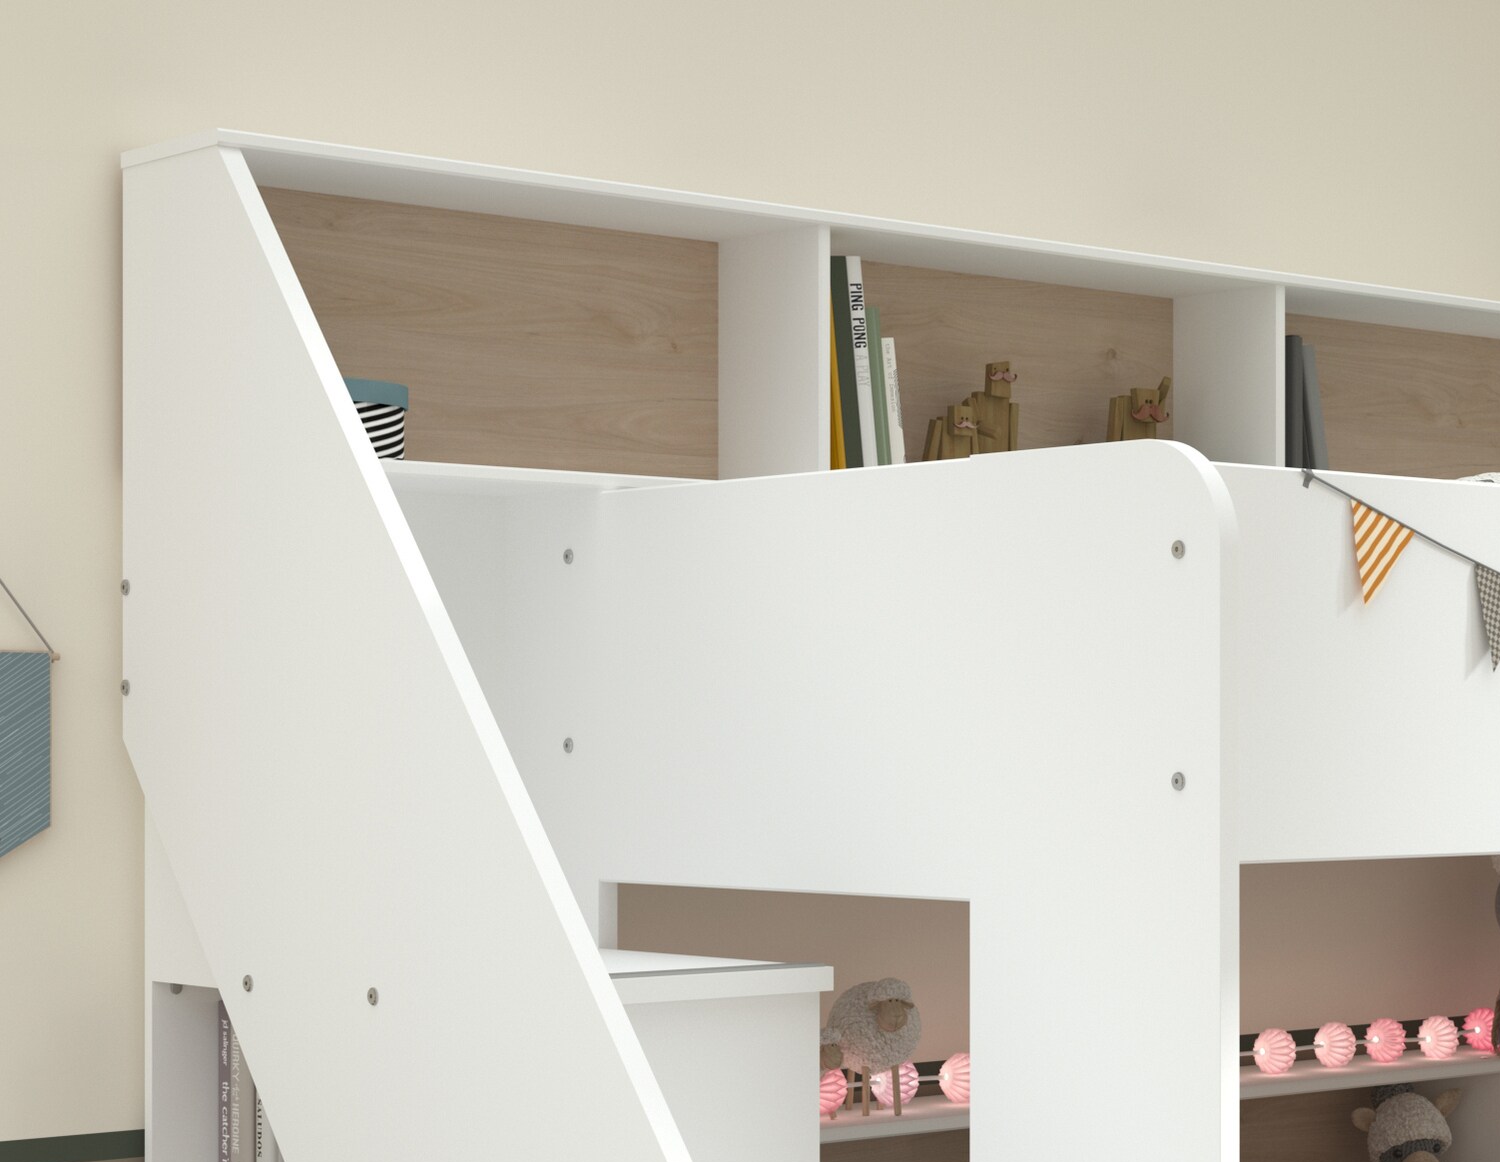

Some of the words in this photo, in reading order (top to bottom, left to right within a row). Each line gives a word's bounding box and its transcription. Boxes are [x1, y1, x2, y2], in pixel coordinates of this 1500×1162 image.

[850, 283, 864, 311] PING
[852, 318, 867, 348] PONG
[855, 365, 871, 387] PLAY
[221, 1031, 229, 1066] salinger
[221, 1081, 230, 1102] the
[221, 1106, 230, 1156] catcher
[231, 1103, 240, 1154] HEROINE
